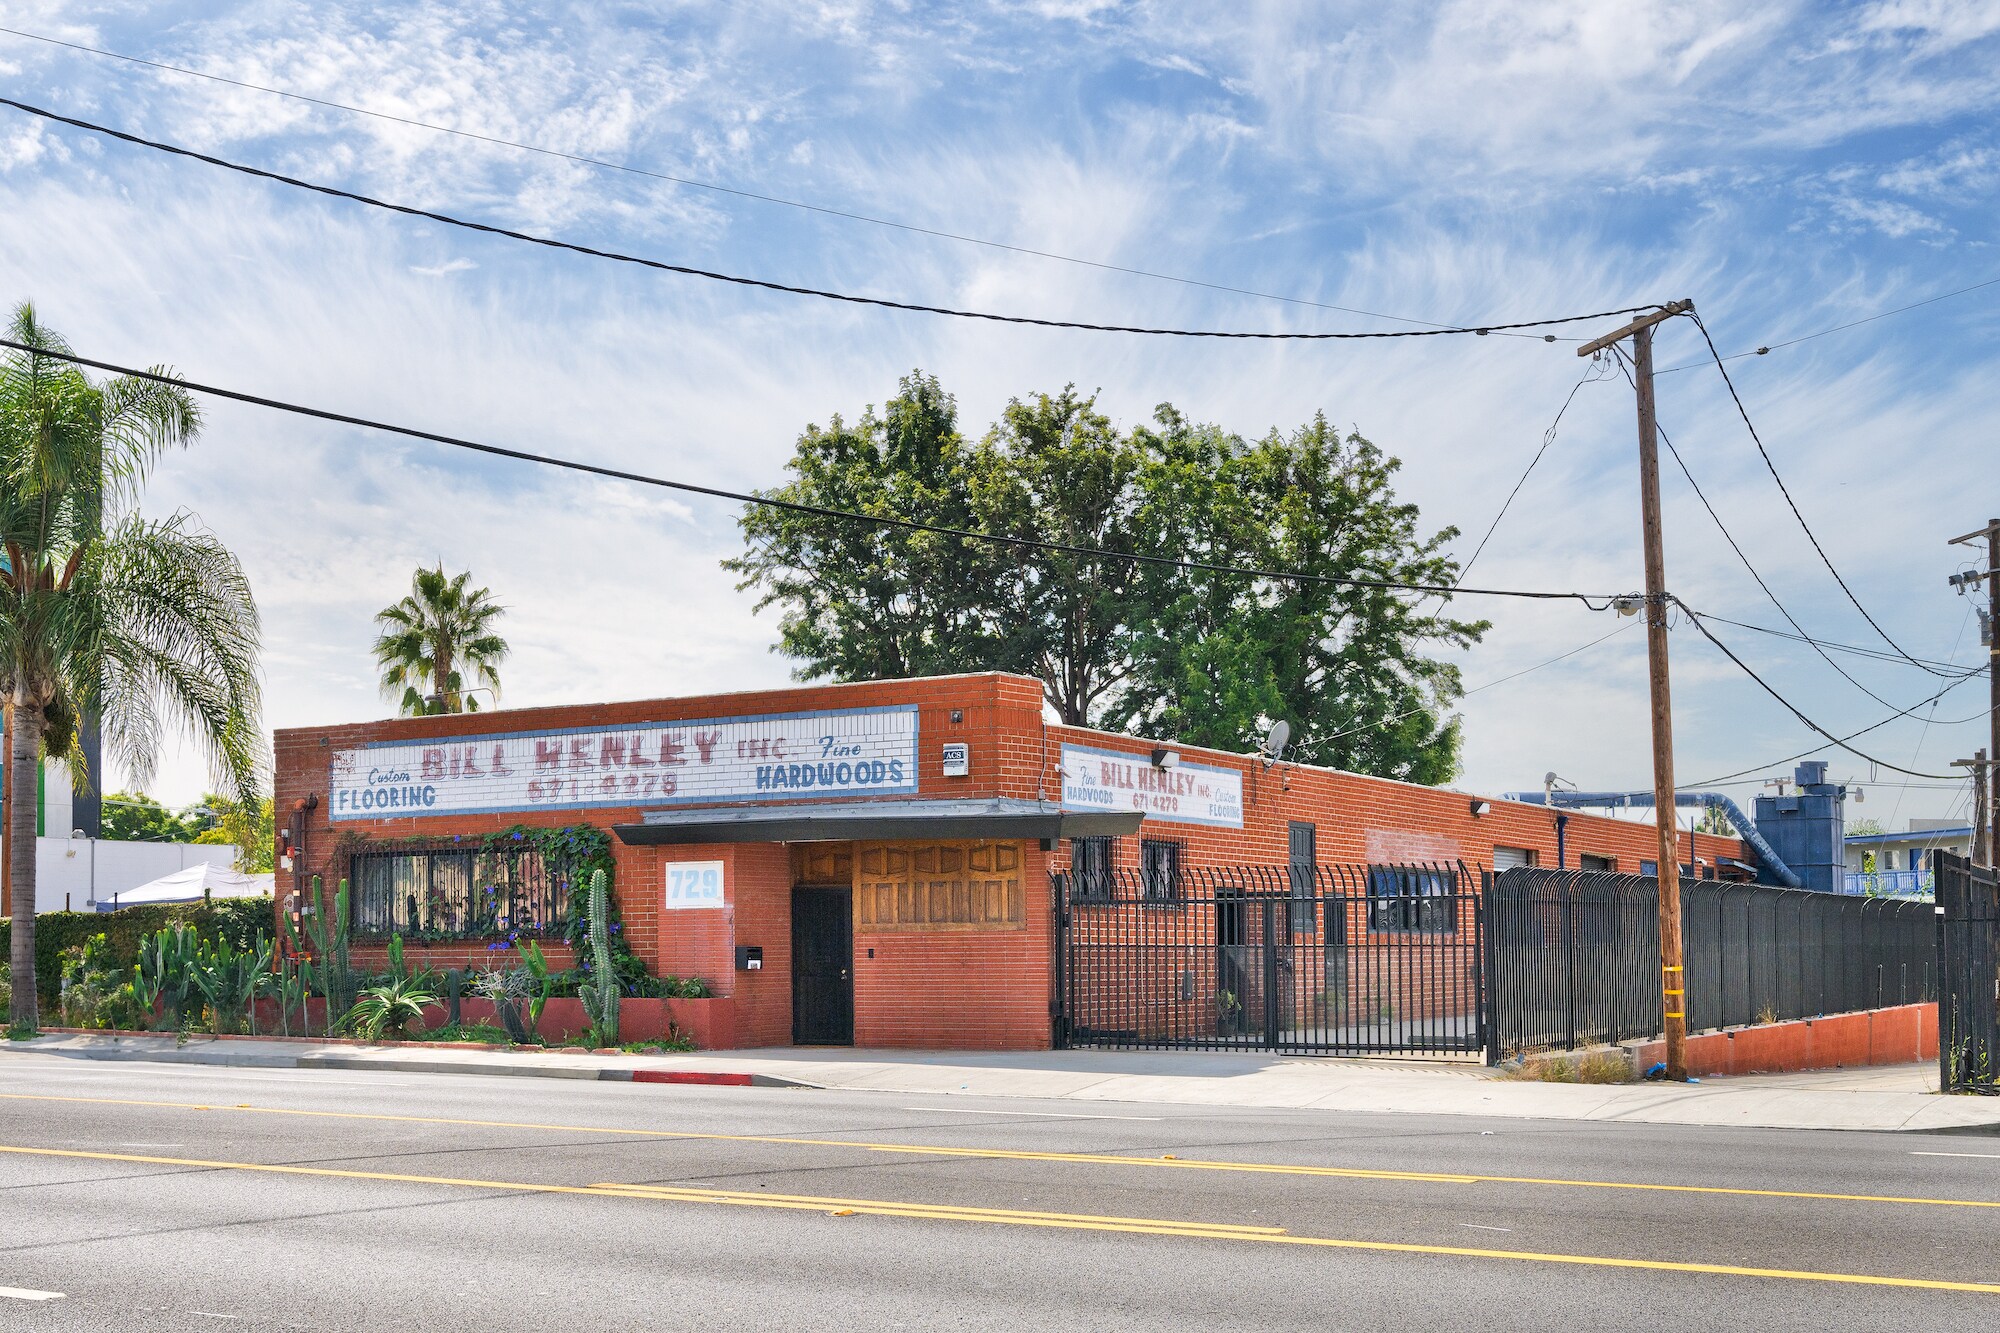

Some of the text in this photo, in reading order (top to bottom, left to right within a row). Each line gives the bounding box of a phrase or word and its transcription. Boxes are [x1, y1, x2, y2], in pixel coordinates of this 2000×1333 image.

[421, 744, 516, 781] BILL
[535, 730, 723, 775] HENLEY
[818, 735, 862, 759] Fine
[945, 750, 962, 759] ACS
[368, 767, 411, 786] Custom
[756, 758, 904, 790] HARDWOODS
[1080, 765, 1097, 787] Fine
[1100, 760, 1134, 790] BILL
[1138, 766, 1196, 797] HENLEY
[338, 784, 436, 811] FLOORING
[1066, 785, 1114, 805] HARDWOODS
[1208, 803, 1241, 820] FLOORING
[670, 869, 718, 899] 729
